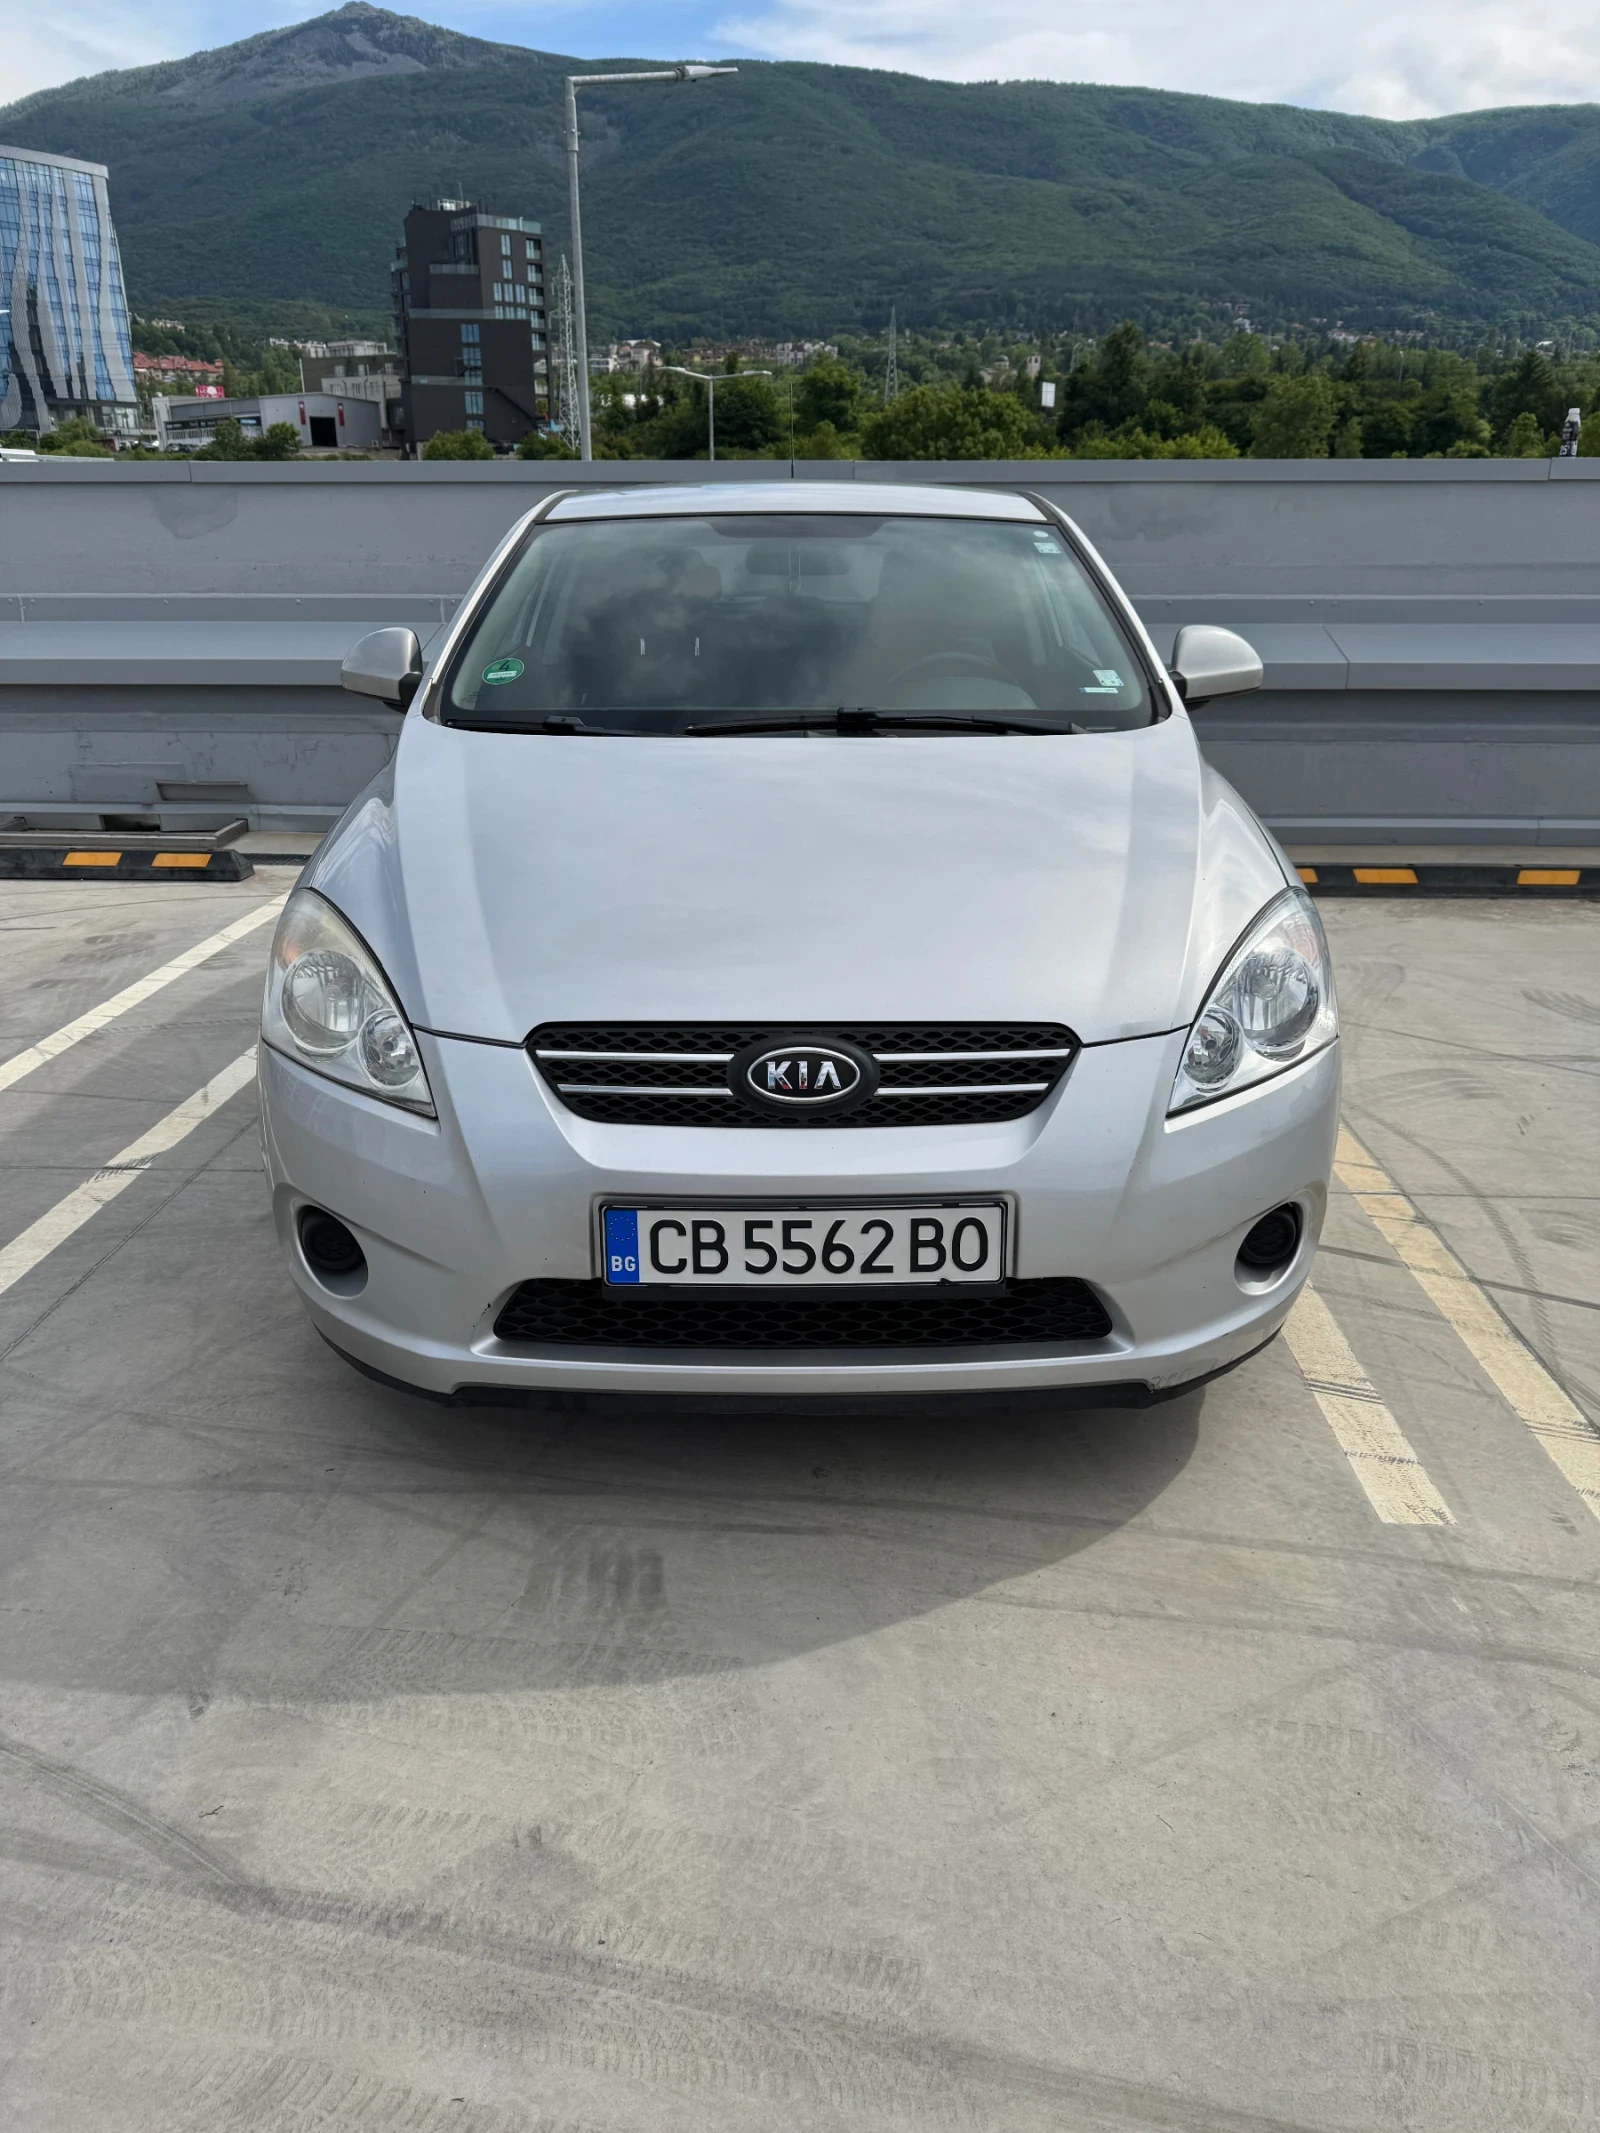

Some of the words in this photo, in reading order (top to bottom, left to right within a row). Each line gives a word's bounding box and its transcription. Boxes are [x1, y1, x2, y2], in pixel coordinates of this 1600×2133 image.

[498, 660, 510, 671] 4
[766, 1061, 842, 1090] KIA
[649, 1218, 730, 1275] CB
[744, 1219, 894, 1275] 5562
[611, 1255, 637, 1273] BG
